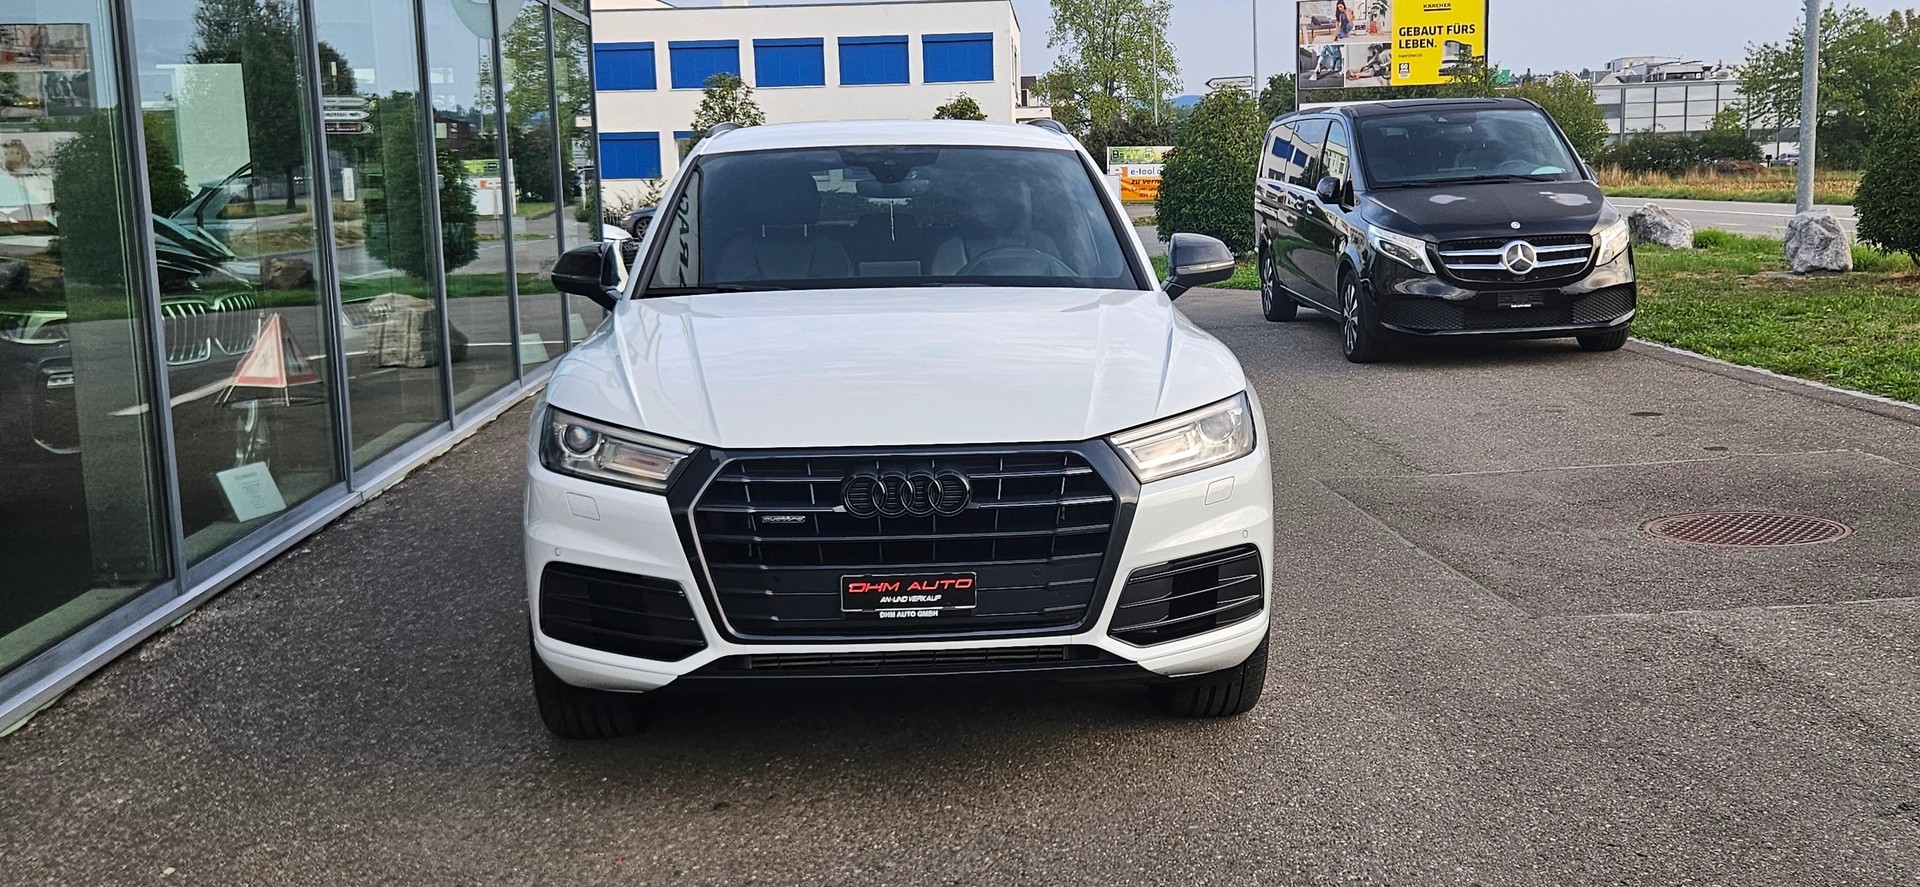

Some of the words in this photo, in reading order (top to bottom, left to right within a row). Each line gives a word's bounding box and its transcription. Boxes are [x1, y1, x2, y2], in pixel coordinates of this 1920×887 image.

[1399, 25, 1444, 37] GEBAUT
[1446, 23, 1475, 35] FÜRS
[1399, 38, 1437, 49] LEBEN.
[1130, 166, 1155, 175] e-tool
[848, 581, 901, 593] DHM
[906, 578, 973, 591] AUTO
[908, 594, 942, 603] VERKAUF
[896, 610, 916, 618] AUTO
